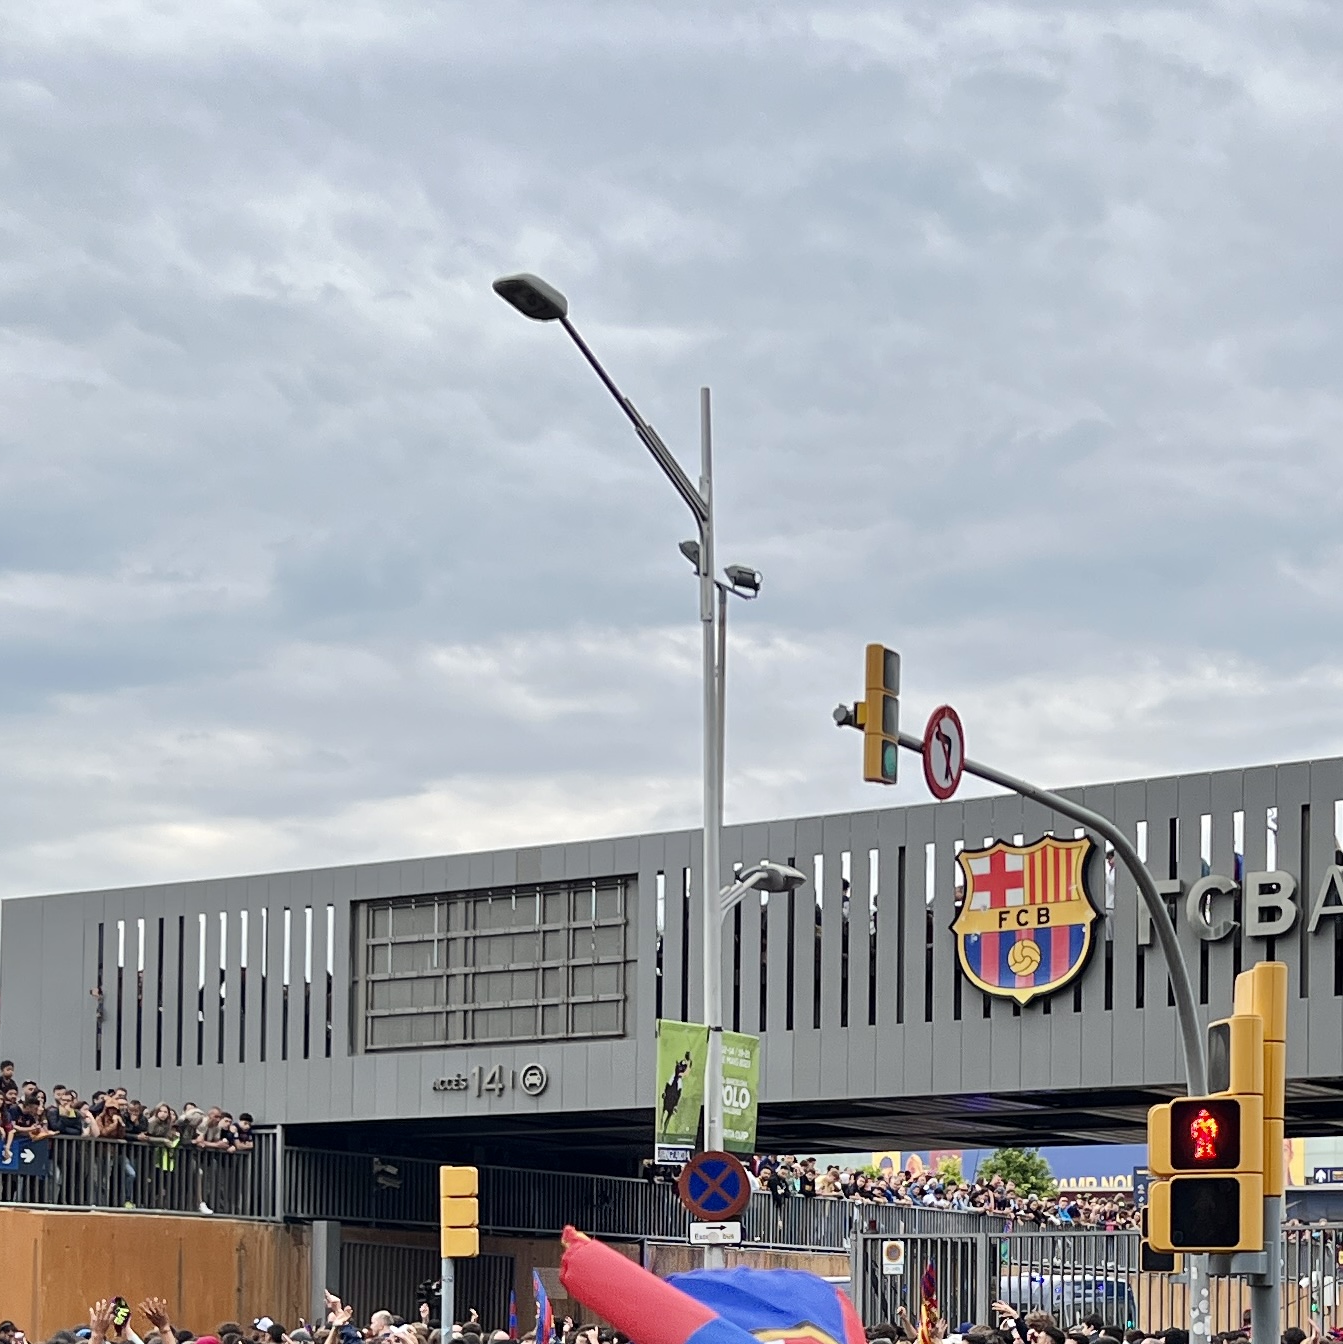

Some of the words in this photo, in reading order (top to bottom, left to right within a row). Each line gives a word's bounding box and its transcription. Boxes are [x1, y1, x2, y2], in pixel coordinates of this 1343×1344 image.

[998, 907, 1050, 929] FCB
[472, 1064, 505, 1098] 14
[722, 1085, 751, 1109] OLO
